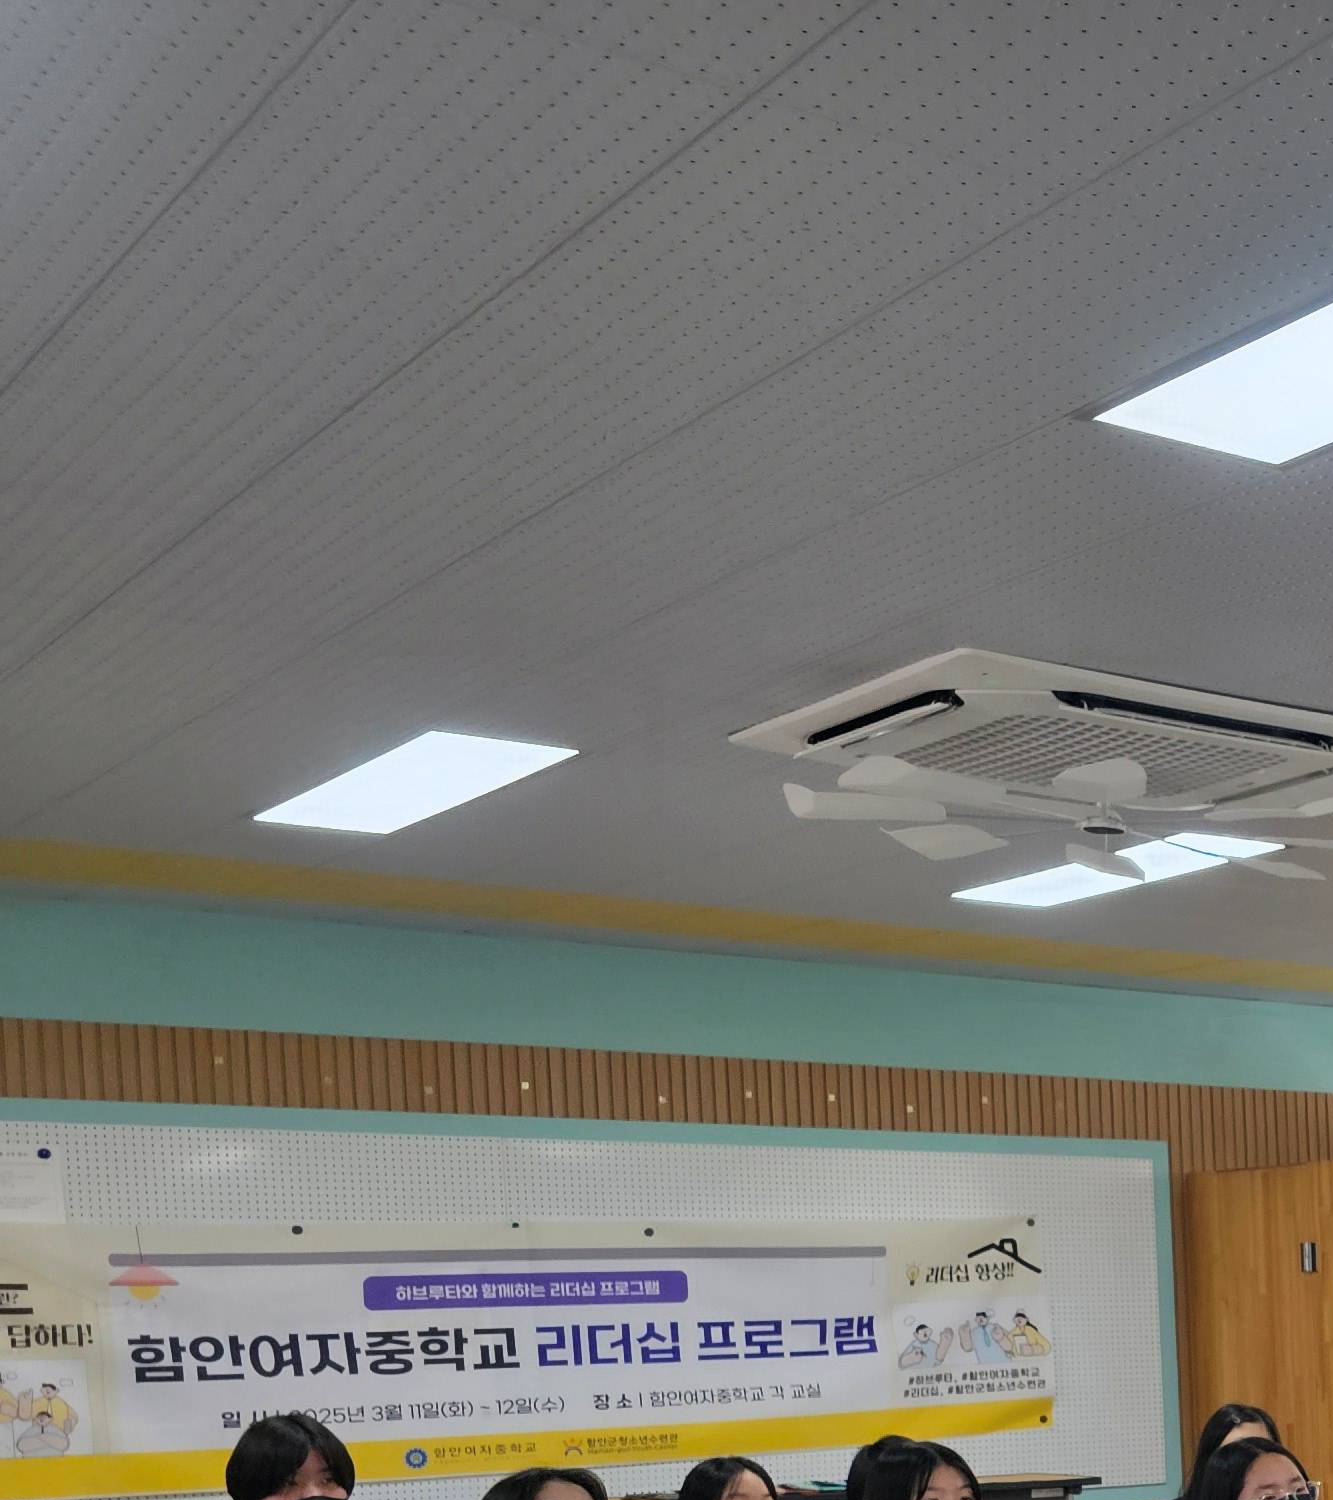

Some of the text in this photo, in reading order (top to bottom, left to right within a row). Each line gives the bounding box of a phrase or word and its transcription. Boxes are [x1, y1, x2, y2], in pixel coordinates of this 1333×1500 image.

[925, 1264, 970, 1284] 리더십
[395, 1279, 660, 1300] 하브루타와 함께하는 리더십 프로그램
[127, 1315, 878, 1384] 함안여자중학교 리더십 프로그램
[372, 1403, 403, 1421] 3월
[409, 1399, 474, 1419] 11일(화)
[494, 1395, 566, 1416] 12일(수)
[592, 1393, 610, 1411] 장
[649, 1385, 766, 1408] 함안여자중학교
[791, 1382, 822, 1400] 교실
[221, 1411, 241, 1429] 일
